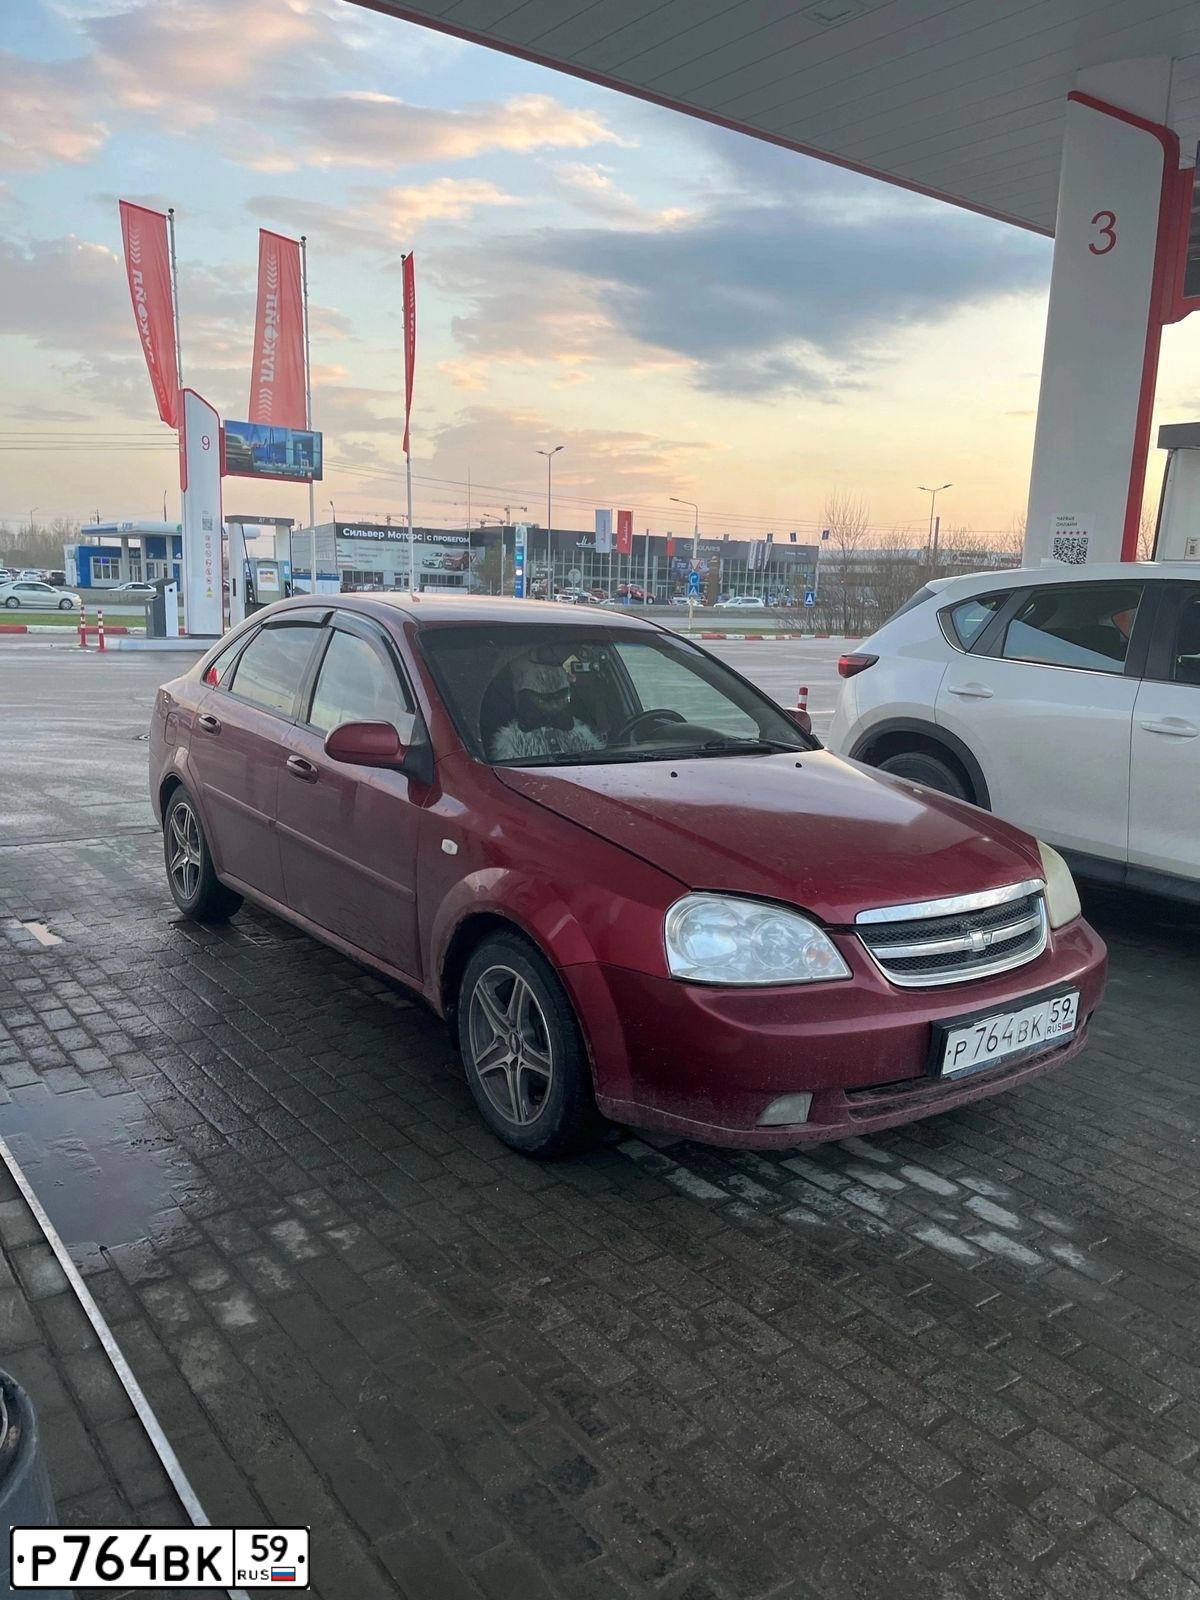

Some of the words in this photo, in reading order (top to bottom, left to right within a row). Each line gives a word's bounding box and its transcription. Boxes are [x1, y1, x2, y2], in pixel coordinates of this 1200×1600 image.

[1088, 210, 1117, 255] 3
[201, 435, 211, 450] 9
[342, 527, 385, 540] Сильвер
[433, 535, 470, 544] ПРОБЕГОМ
[953, 1012, 1043, 1066] Р764ВК
[1050, 997, 1072, 1023] 59
[1046, 1023, 1062, 1035] RUS
